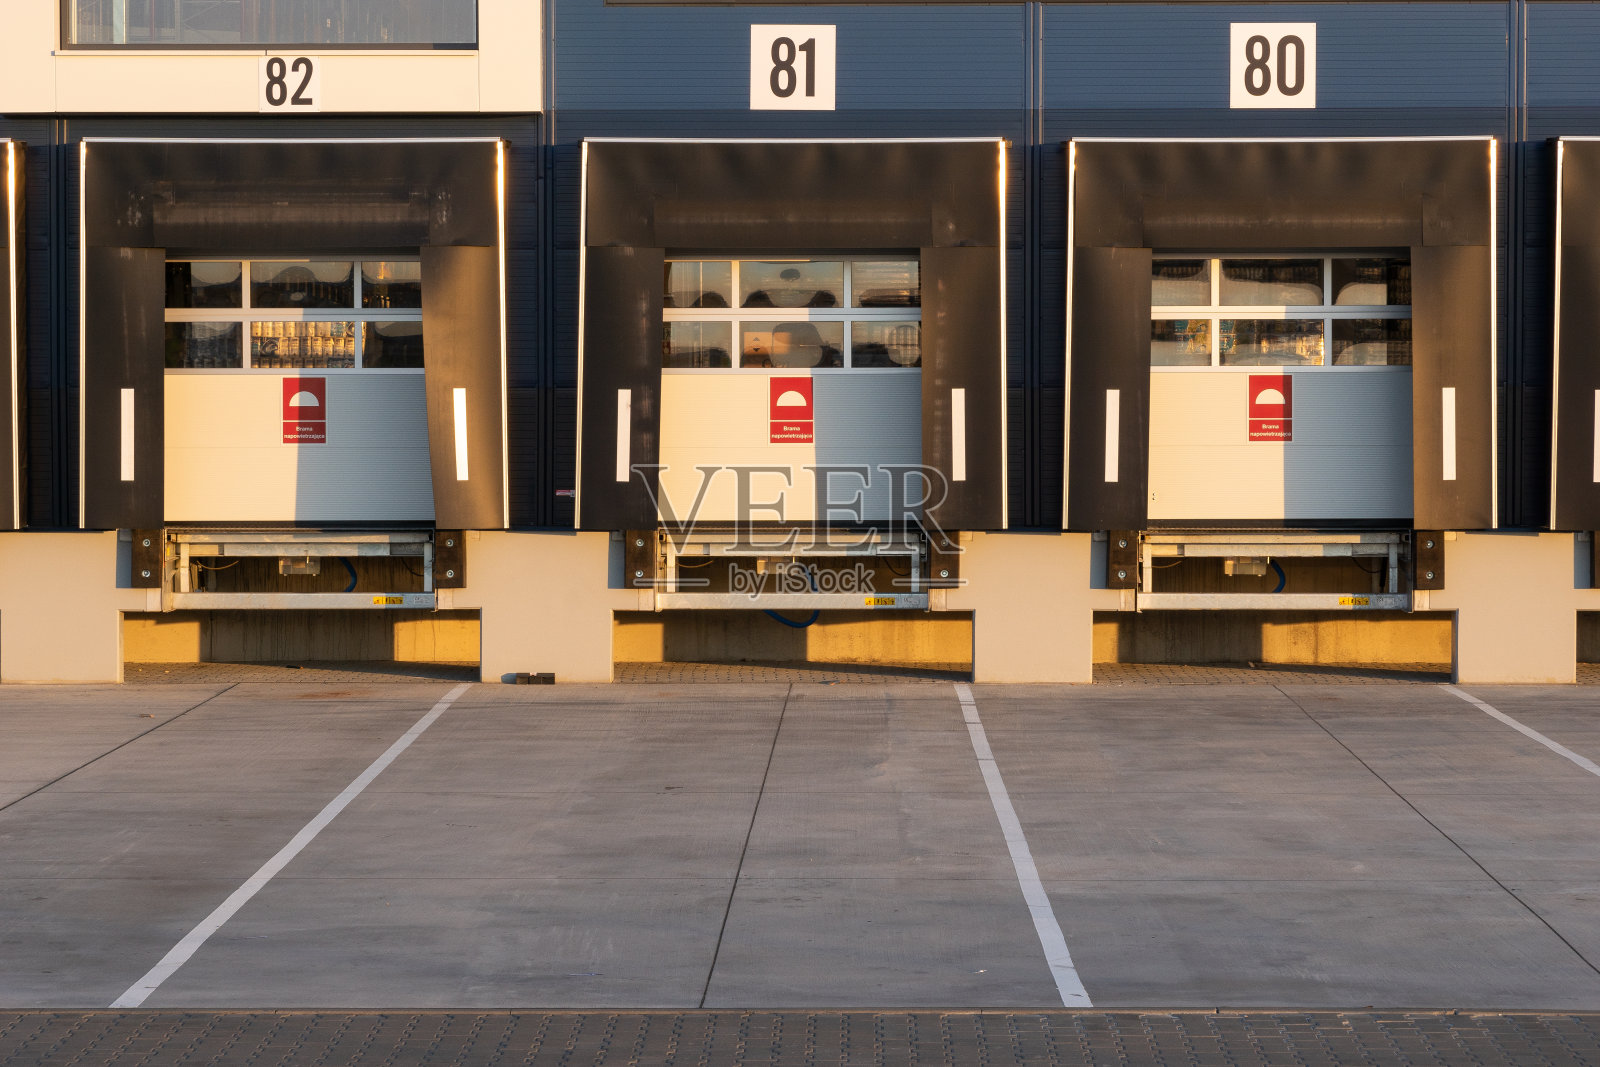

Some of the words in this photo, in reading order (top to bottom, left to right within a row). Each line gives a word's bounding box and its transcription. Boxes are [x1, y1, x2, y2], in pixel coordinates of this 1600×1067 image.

[265, 57, 313, 107] 82
[769, 37, 816, 97] 81
[1244, 35, 1305, 97] 80
